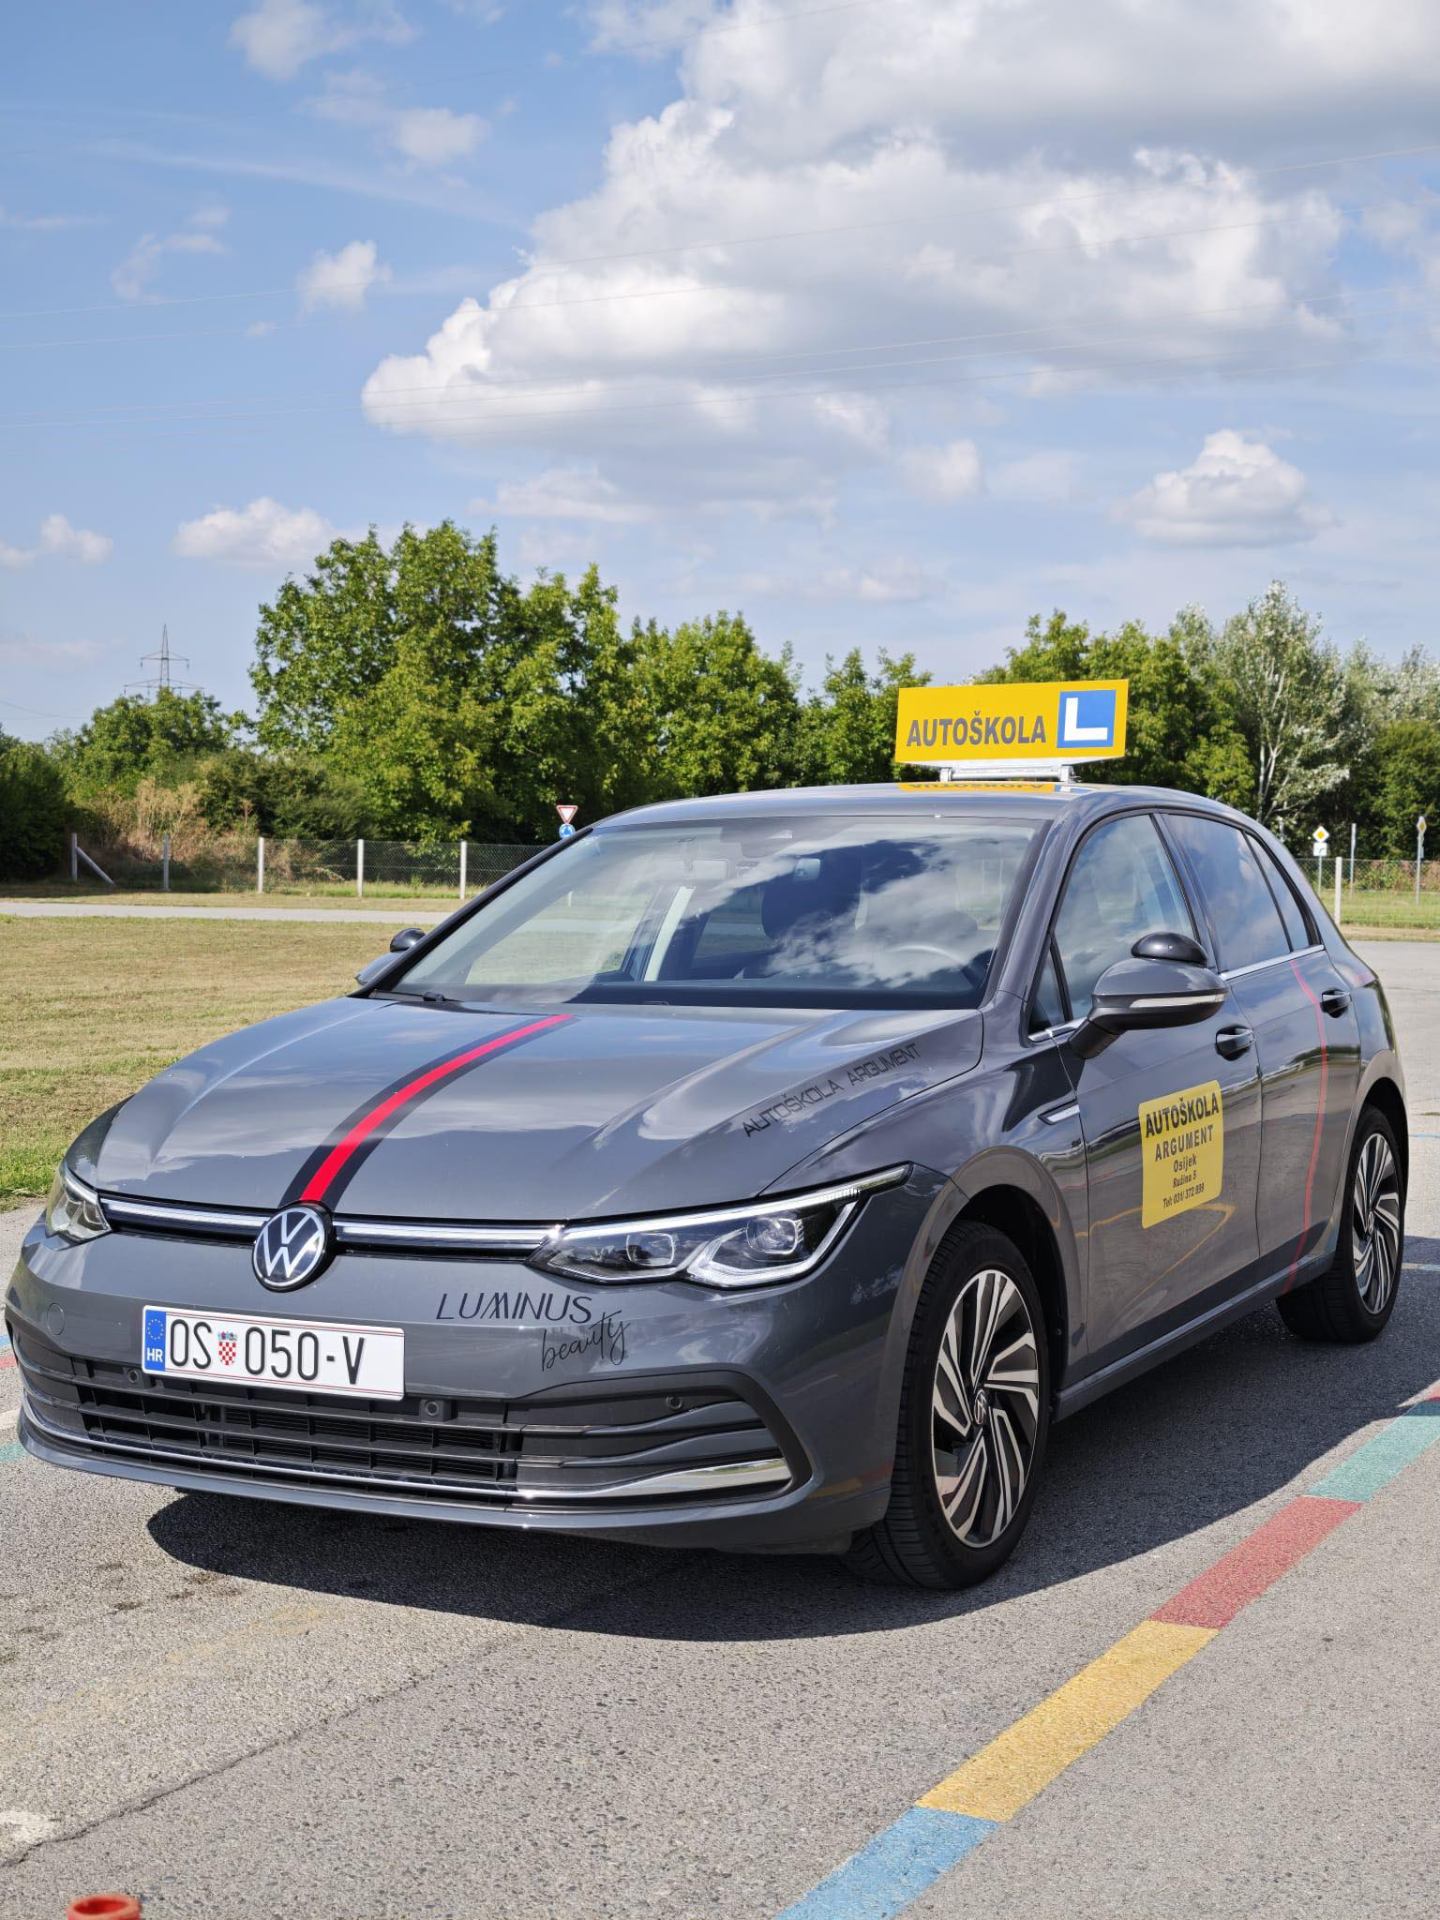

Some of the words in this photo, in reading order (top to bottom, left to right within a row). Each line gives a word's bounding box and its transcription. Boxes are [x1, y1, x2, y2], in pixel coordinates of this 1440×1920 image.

[907, 710, 1047, 747] AUTOŠKOLA
[1064, 697, 1108, 741] L
[742, 1079, 845, 1137] AUTOŠKOLA
[846, 1043, 921, 1086] ARGUMENT
[1145, 1092, 1220, 1138] AUTOŠKOLA
[1155, 1124, 1214, 1162] ARGUMENT
[1173, 1154, 1197, 1173] Osijek
[436, 1292, 592, 1324] LUMINUS
[147, 1348, 163, 1363] HR
[170, 1319, 212, 1369] OS
[245, 1326, 365, 1385] 050-V
[541, 1310, 632, 1371] beauty
